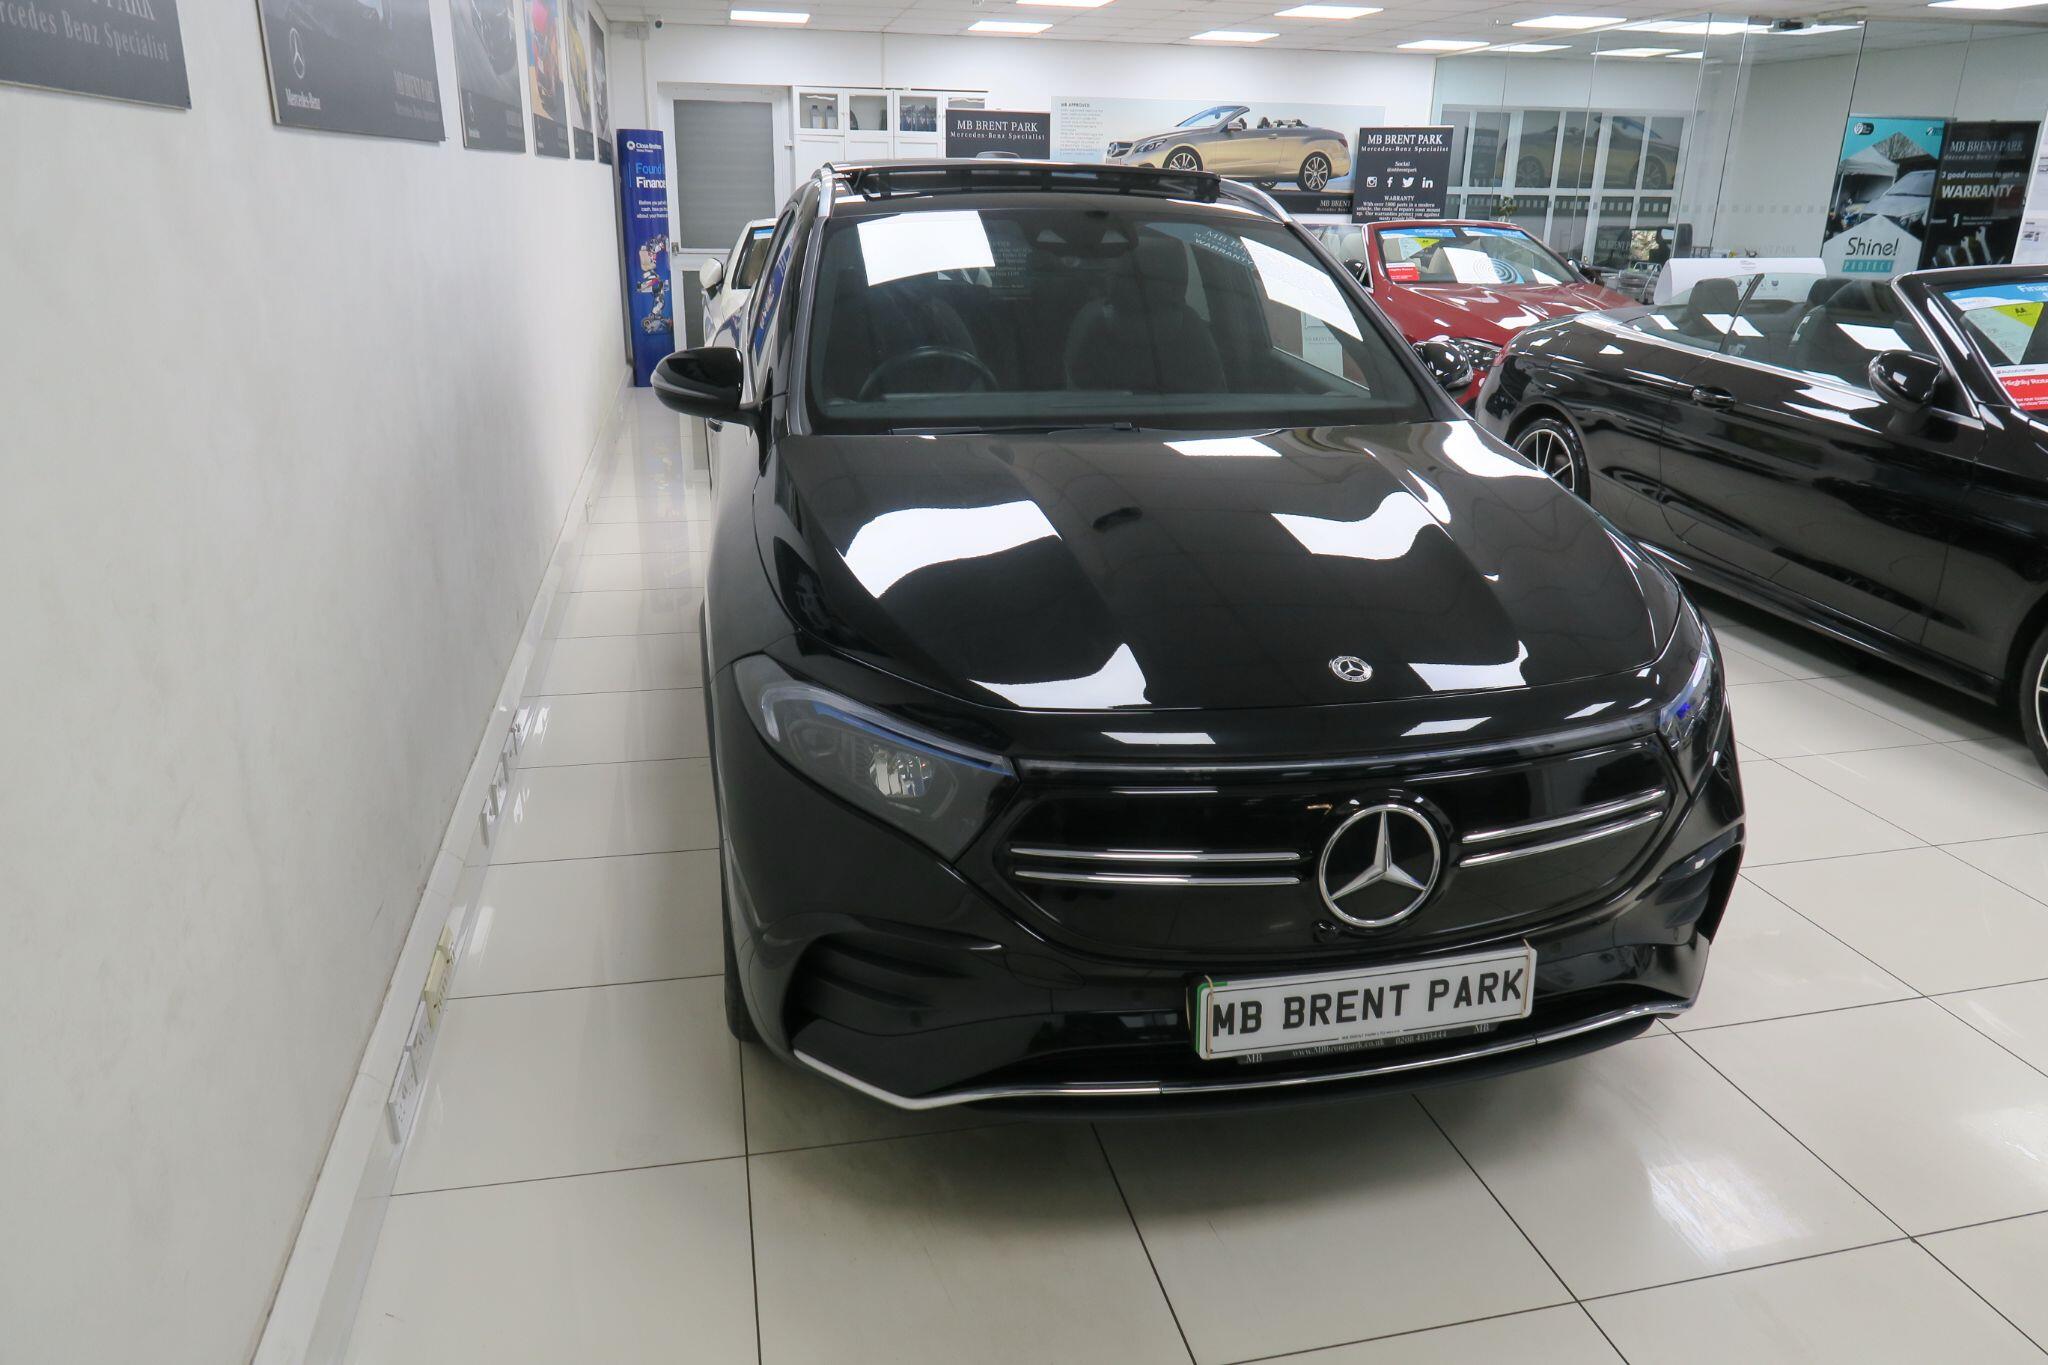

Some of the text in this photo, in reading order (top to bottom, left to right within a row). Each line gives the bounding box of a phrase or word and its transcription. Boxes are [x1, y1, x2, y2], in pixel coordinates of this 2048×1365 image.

[0, 2, 169, 62] rcedes Benz Specialist
[957, 120, 1038, 132] MB BRENT PARK
[950, 131, 1005, 139] Mercedes-Benz
[1367, 134, 1443, 145] MB BRENT PARK
[1414, 146, 1449, 154] Specialist
[1951, 141, 2023, 151] MB BRENT PARK
[636, 162, 662, 174] Found
[1948, 171, 1965, 180] good
[2002, 171, 2013, 179] get
[1942, 184, 2015, 198] WARRANTY
[1953, 213, 1960, 227] 1
[1846, 237, 1899, 256] Shine!
[1844, 261, 1892, 271] PROTECT
[1212, 968, 1524, 1037] MB BRENT PARK
[1474, 1023, 1489, 1034] MB
[1246, 1053, 1263, 1064] MB
